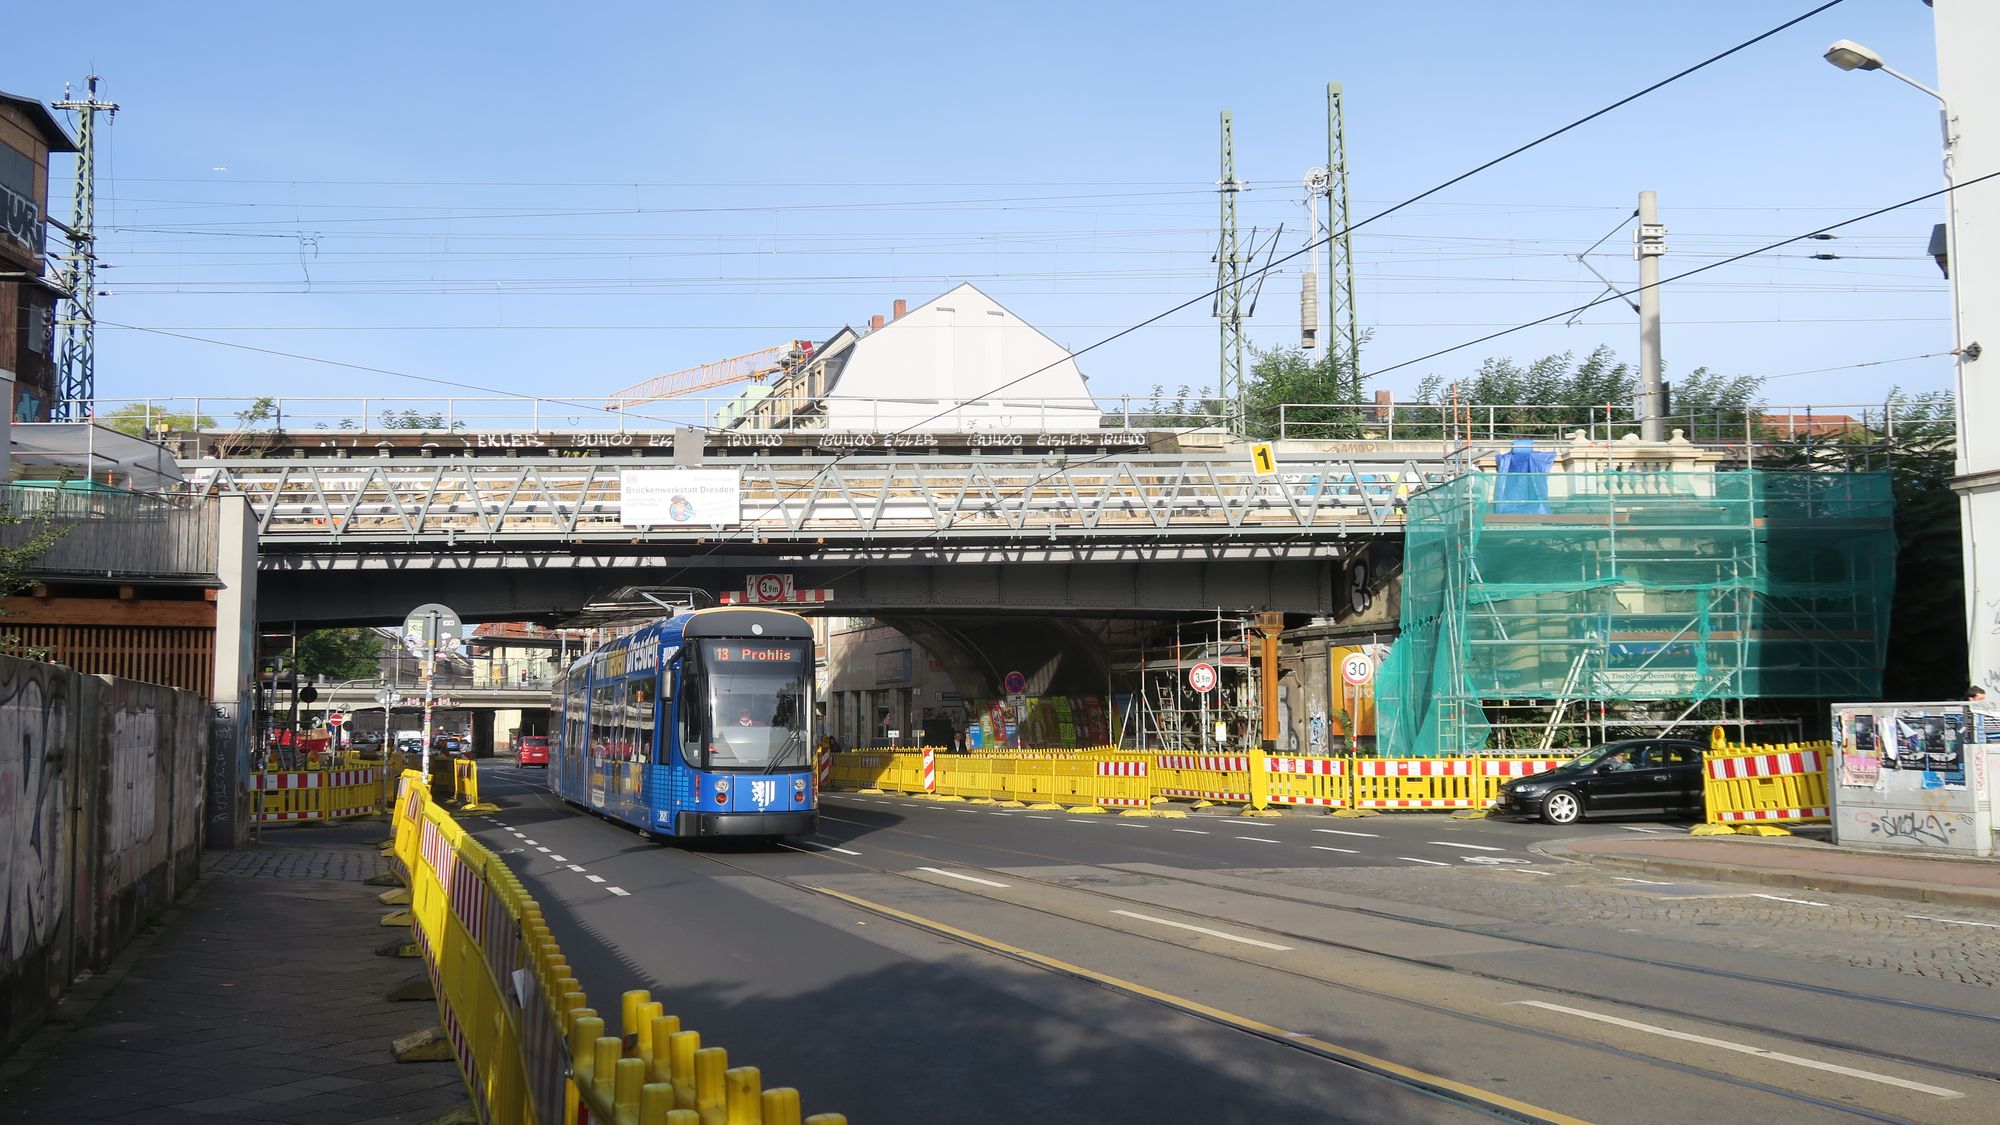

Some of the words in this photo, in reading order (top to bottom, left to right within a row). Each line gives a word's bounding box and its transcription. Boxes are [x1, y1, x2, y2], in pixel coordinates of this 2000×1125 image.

[1257, 447, 1271, 470] 1
[625, 486, 698, 494] Brückenwerkstatt
[700, 486, 735, 494] Dresden
[715, 648, 729, 661] 13
[741, 648, 791, 661] Prohlis
[1348, 661, 1367, 676] 30
